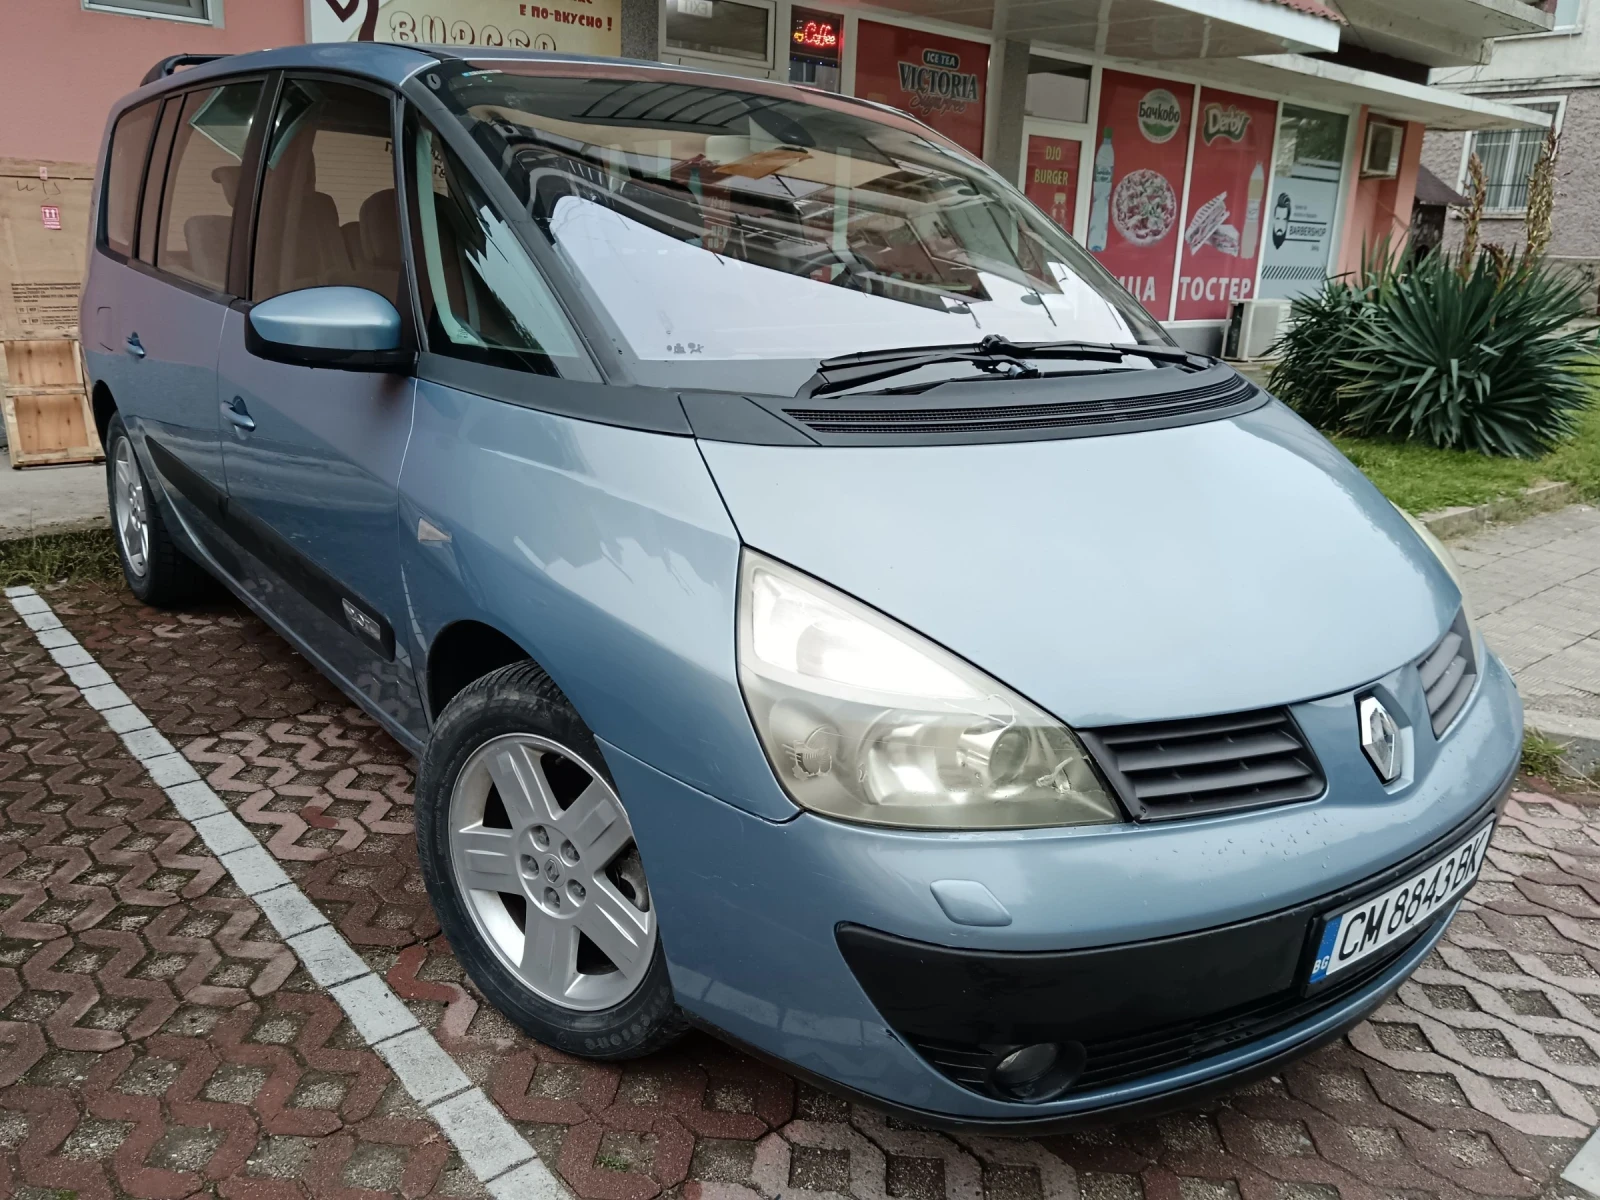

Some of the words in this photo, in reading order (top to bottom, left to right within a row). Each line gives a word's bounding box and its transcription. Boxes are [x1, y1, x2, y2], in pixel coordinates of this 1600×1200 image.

[531, 5, 603, 29] ПО-ВКУСНО
[804, 21, 836, 46] Coffee
[926, 52, 940, 63] ICE
[941, 54, 956, 67] TEA
[898, 62, 978, 101] VICTORIA
[1138, 101, 1180, 123] Бачково
[1208, 107, 1246, 134] Derby
[1045, 145, 1062, 161] DJO
[1034, 168, 1069, 186] BURGER
[1179, 276, 1251, 301] ТОСТЕР
[1338, 898, 1390, 961] CM
[1387, 857, 1455, 935] 8843
[1451, 831, 1486, 889] BK
[1313, 956, 1330, 974] BG
